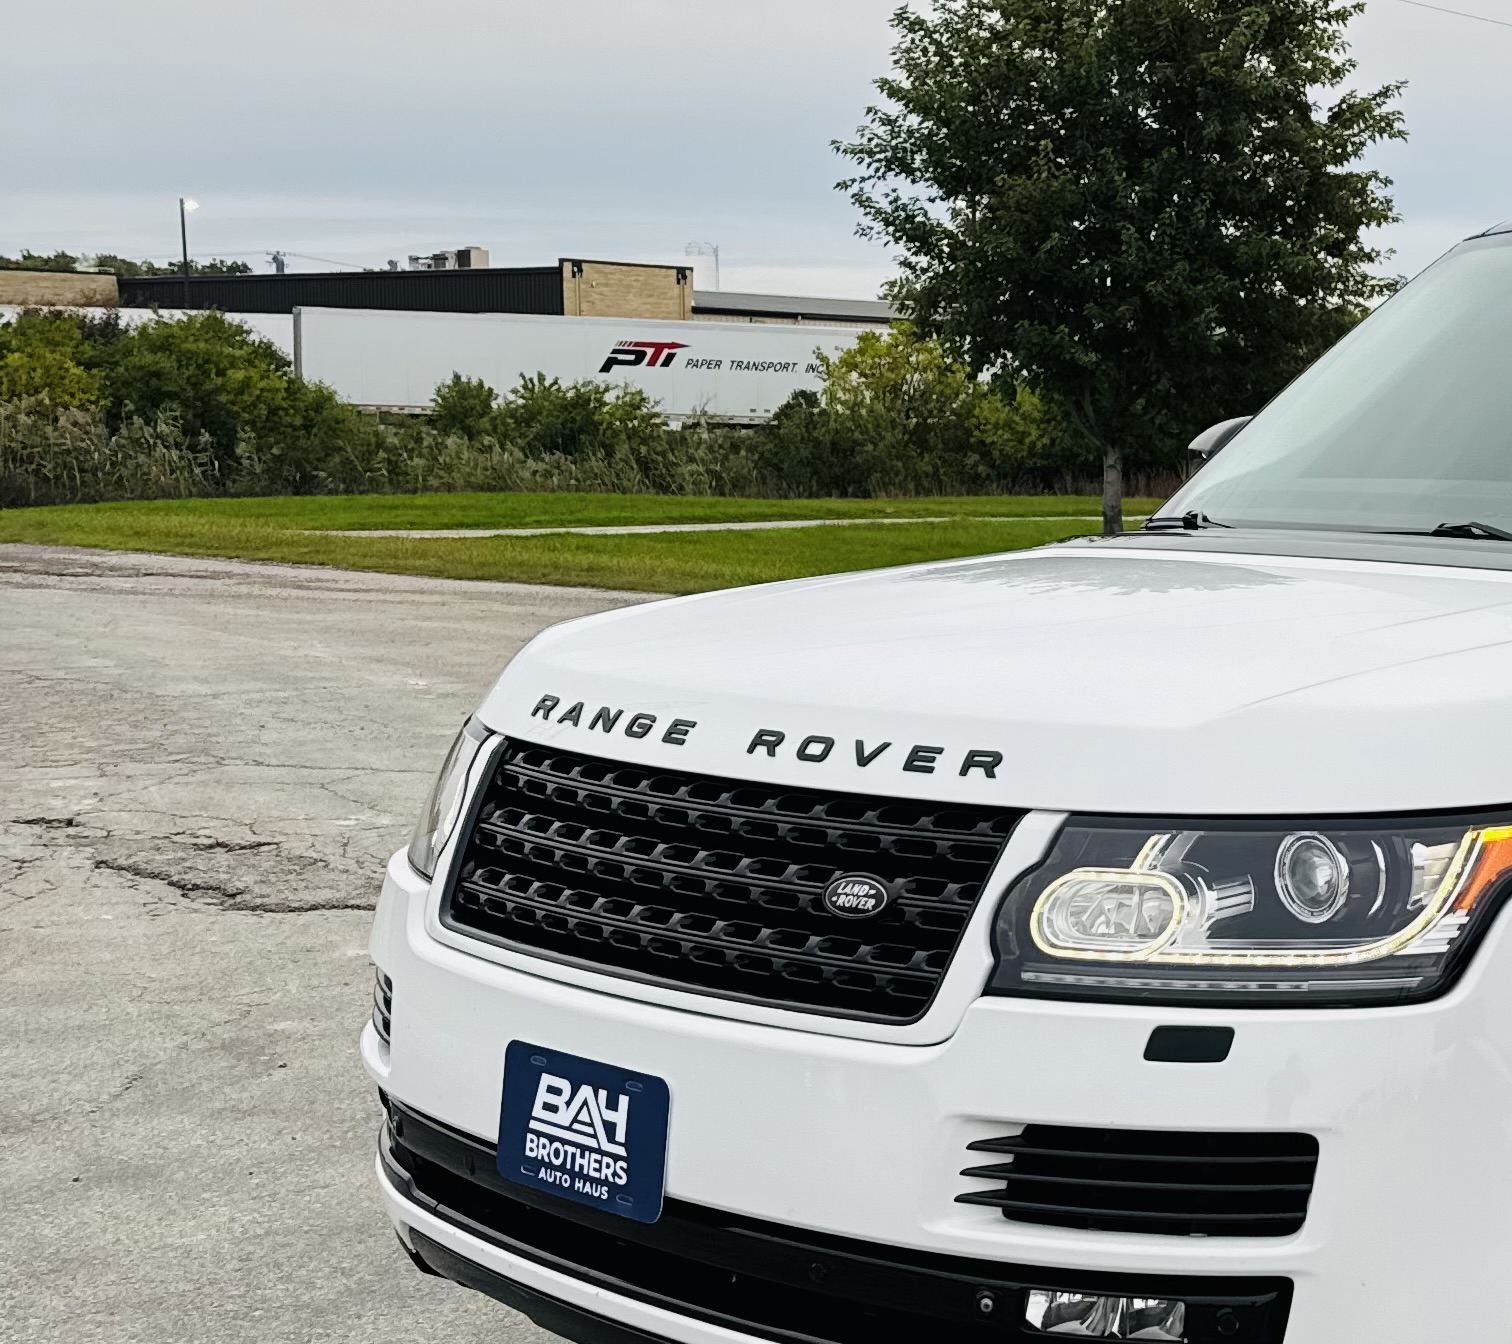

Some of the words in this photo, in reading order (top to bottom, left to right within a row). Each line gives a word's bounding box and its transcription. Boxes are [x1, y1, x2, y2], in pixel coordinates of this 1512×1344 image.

[684, 358, 723, 370] PAPER
[531, 693, 697, 746] RANGE
[746, 728, 1003, 779] ROVER
[835, 894, 876, 911] ROVER
[531, 1072, 630, 1150] BAH
[525, 1132, 628, 1186] BROTHERS
[538, 1166, 571, 1188] AUTO
[574, 1178, 609, 1200] HAUS
